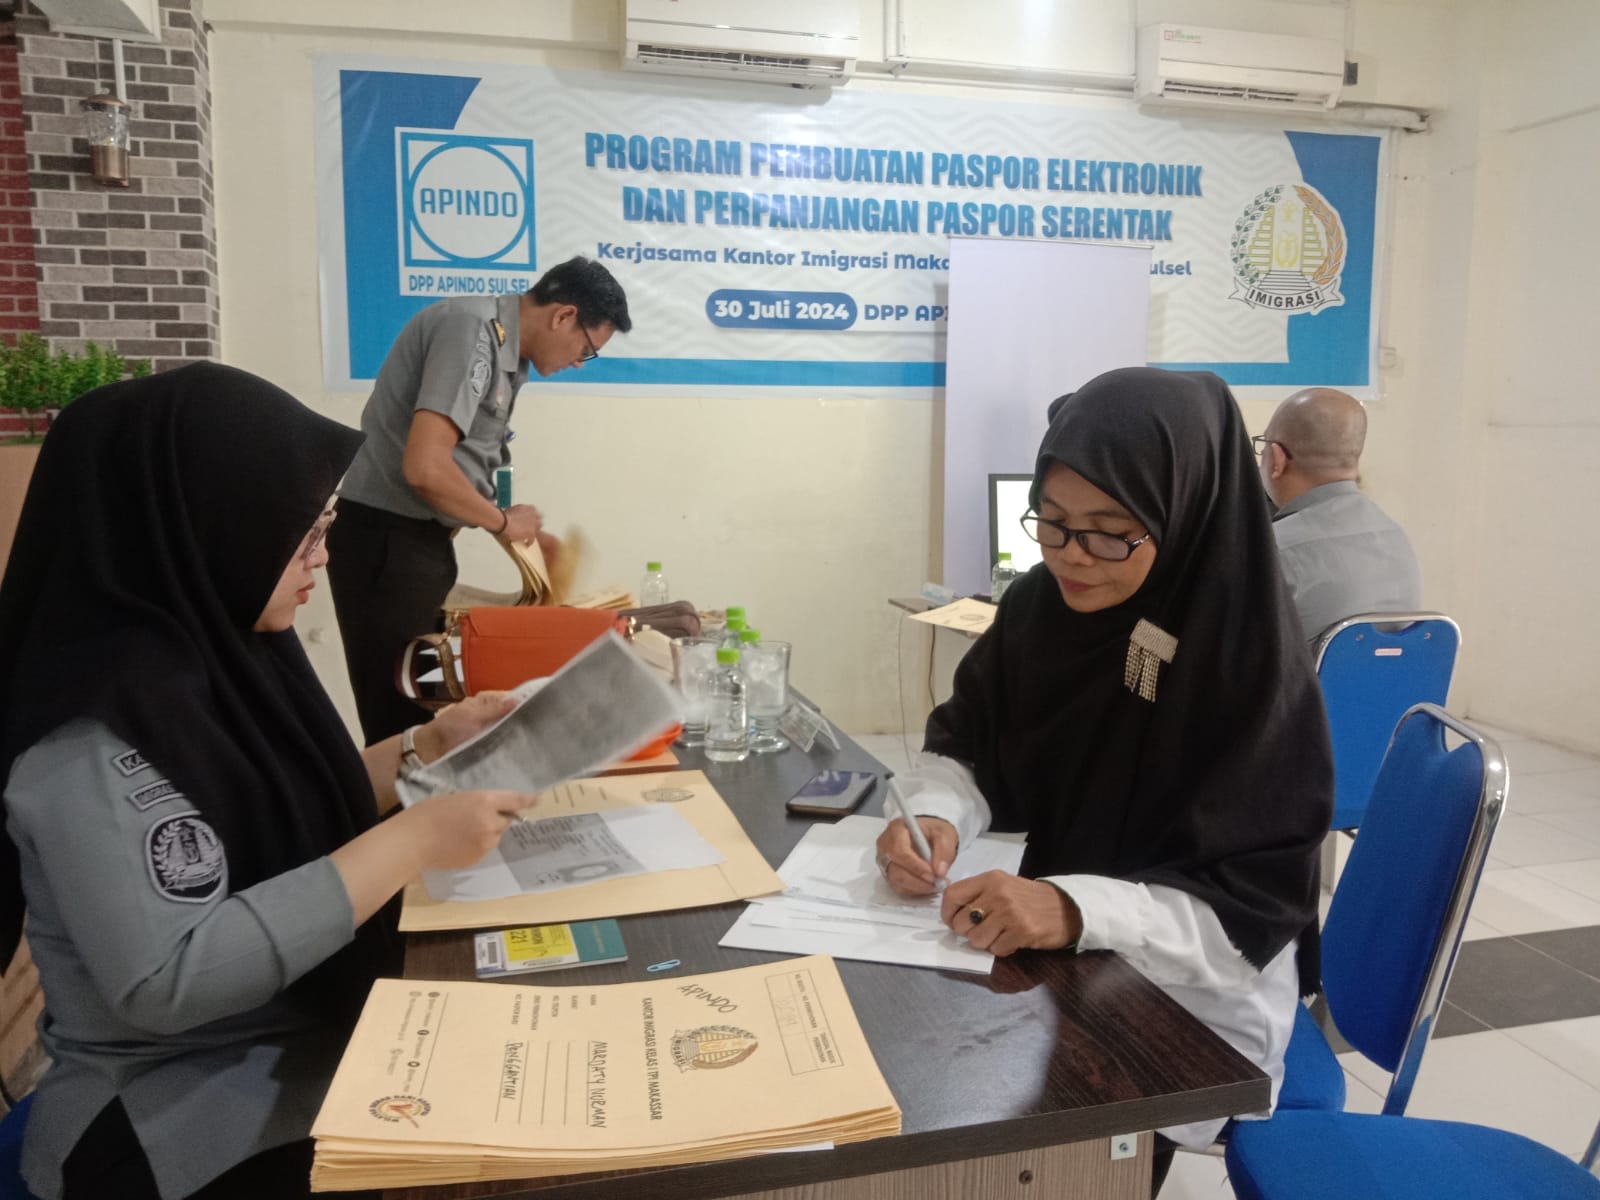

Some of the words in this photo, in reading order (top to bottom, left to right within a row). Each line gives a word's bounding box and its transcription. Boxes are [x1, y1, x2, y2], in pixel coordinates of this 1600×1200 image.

[585, 132, 742, 176] PROGRAM
[749, 143, 924, 186] PEMBUATAN
[931, 152, 1040, 190] PASPOR
[1046, 158, 1203, 197] ELEKTRONIK
[420, 187, 518, 218] APINDO
[622, 186, 687, 223] DAN
[693, 190, 919, 234] PERPANJANGAN
[926, 201, 1035, 237] PASPOR
[1041, 205, 1173, 241] SERENTAK
[597, 242, 717, 265] Kerjasama
[723, 248, 795, 266] Kantor
[801, 250, 888, 272] Imigrasi
[408, 275, 434, 292] DPP
[437, 276, 485, 293] APINDO
[1248, 288, 1321, 308] IMIGRASI
[715, 300, 742, 318] 30
[748, 300, 790, 320] Juli
[795, 302, 850, 321] 2024
[864, 304, 909, 321] DPP
[677, 983, 737, 1013] APINDO
[589, 1087, 607, 1129] NURMAN
[648, 1081, 663, 1121] MAKASSAR
